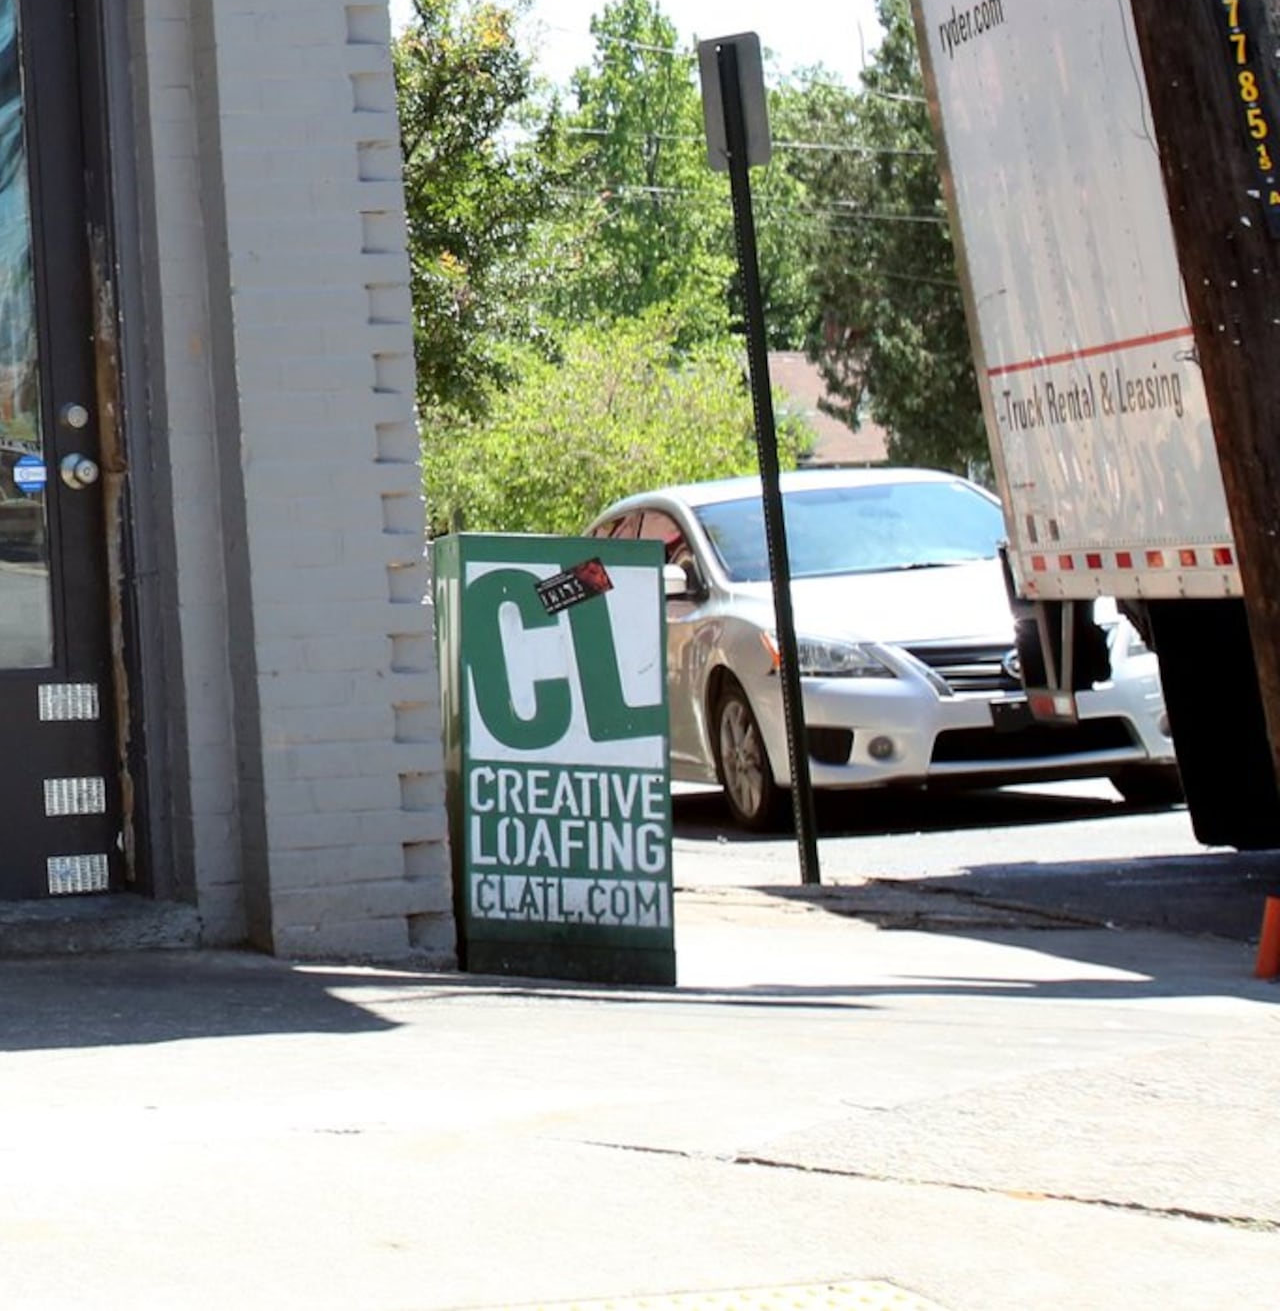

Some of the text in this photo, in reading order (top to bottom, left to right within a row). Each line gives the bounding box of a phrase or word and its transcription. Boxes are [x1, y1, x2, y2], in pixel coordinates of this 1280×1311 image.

[1045, 373, 1097, 425] Rental
[1099, 372, 1115, 416] &
[1115, 361, 1184, 418] Leasing
[461, 566, 666, 751] CL
[469, 766, 666, 821] CREATIVE
[470, 815, 667, 874] LOAFING
[475, 878, 663, 921] CLATL.COM
